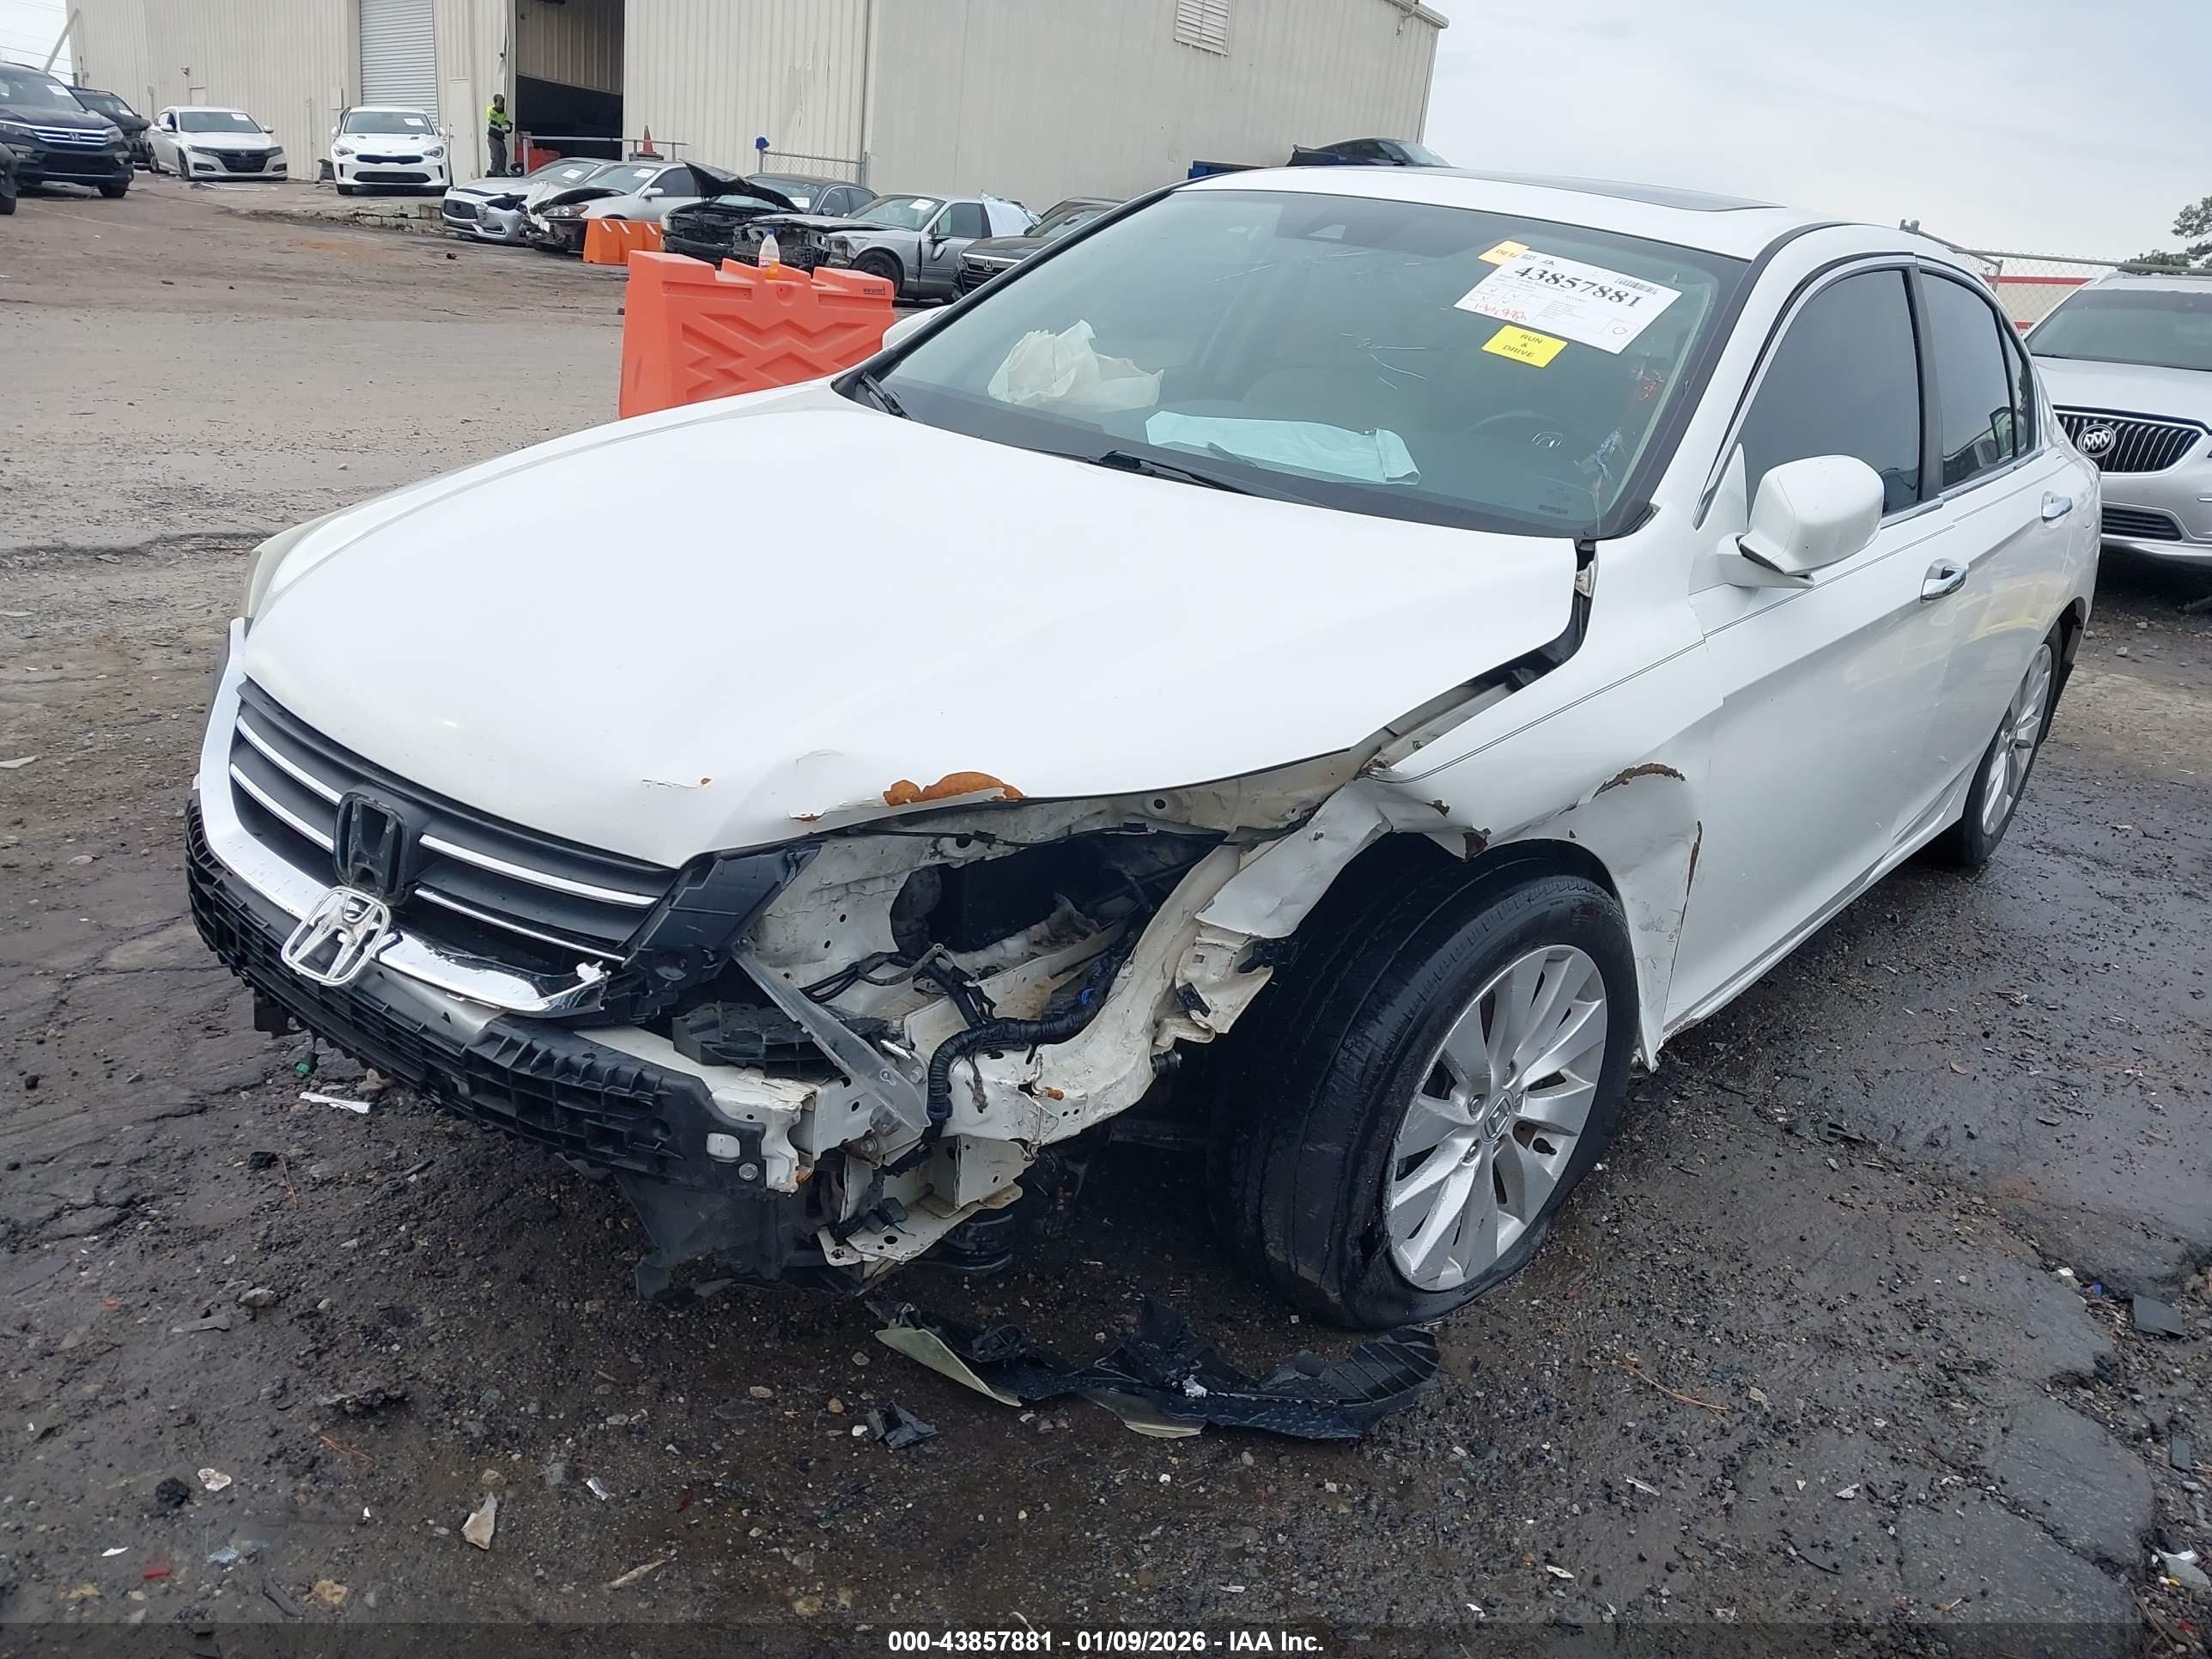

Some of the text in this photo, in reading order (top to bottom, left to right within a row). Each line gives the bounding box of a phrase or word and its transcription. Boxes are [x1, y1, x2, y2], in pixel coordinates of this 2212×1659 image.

[1515, 266, 1643, 307] 43857881
[1520, 334, 1543, 344] RUN
[1503, 344, 1535, 358] DRIVE
